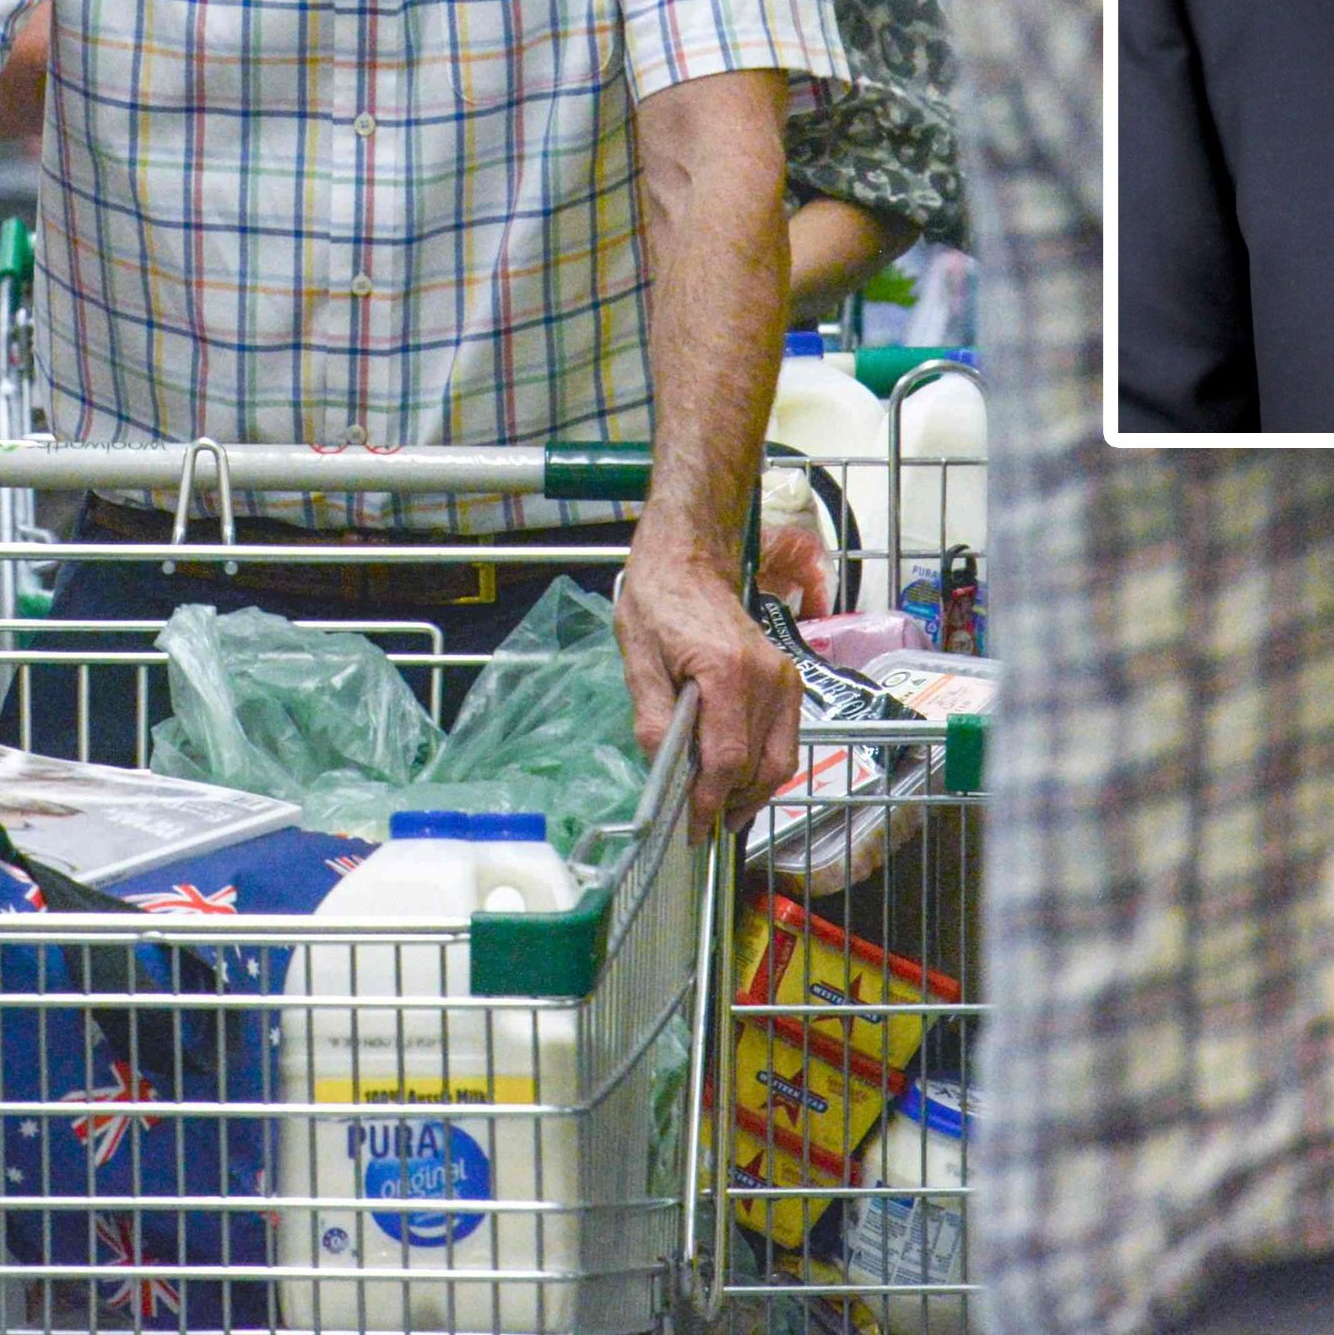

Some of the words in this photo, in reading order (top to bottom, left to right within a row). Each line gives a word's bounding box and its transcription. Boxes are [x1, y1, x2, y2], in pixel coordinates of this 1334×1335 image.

[759, 1071, 800, 1099] WSTERN
[348, 1123, 438, 1160] PURA
[380, 1158, 467, 1201] orginal
